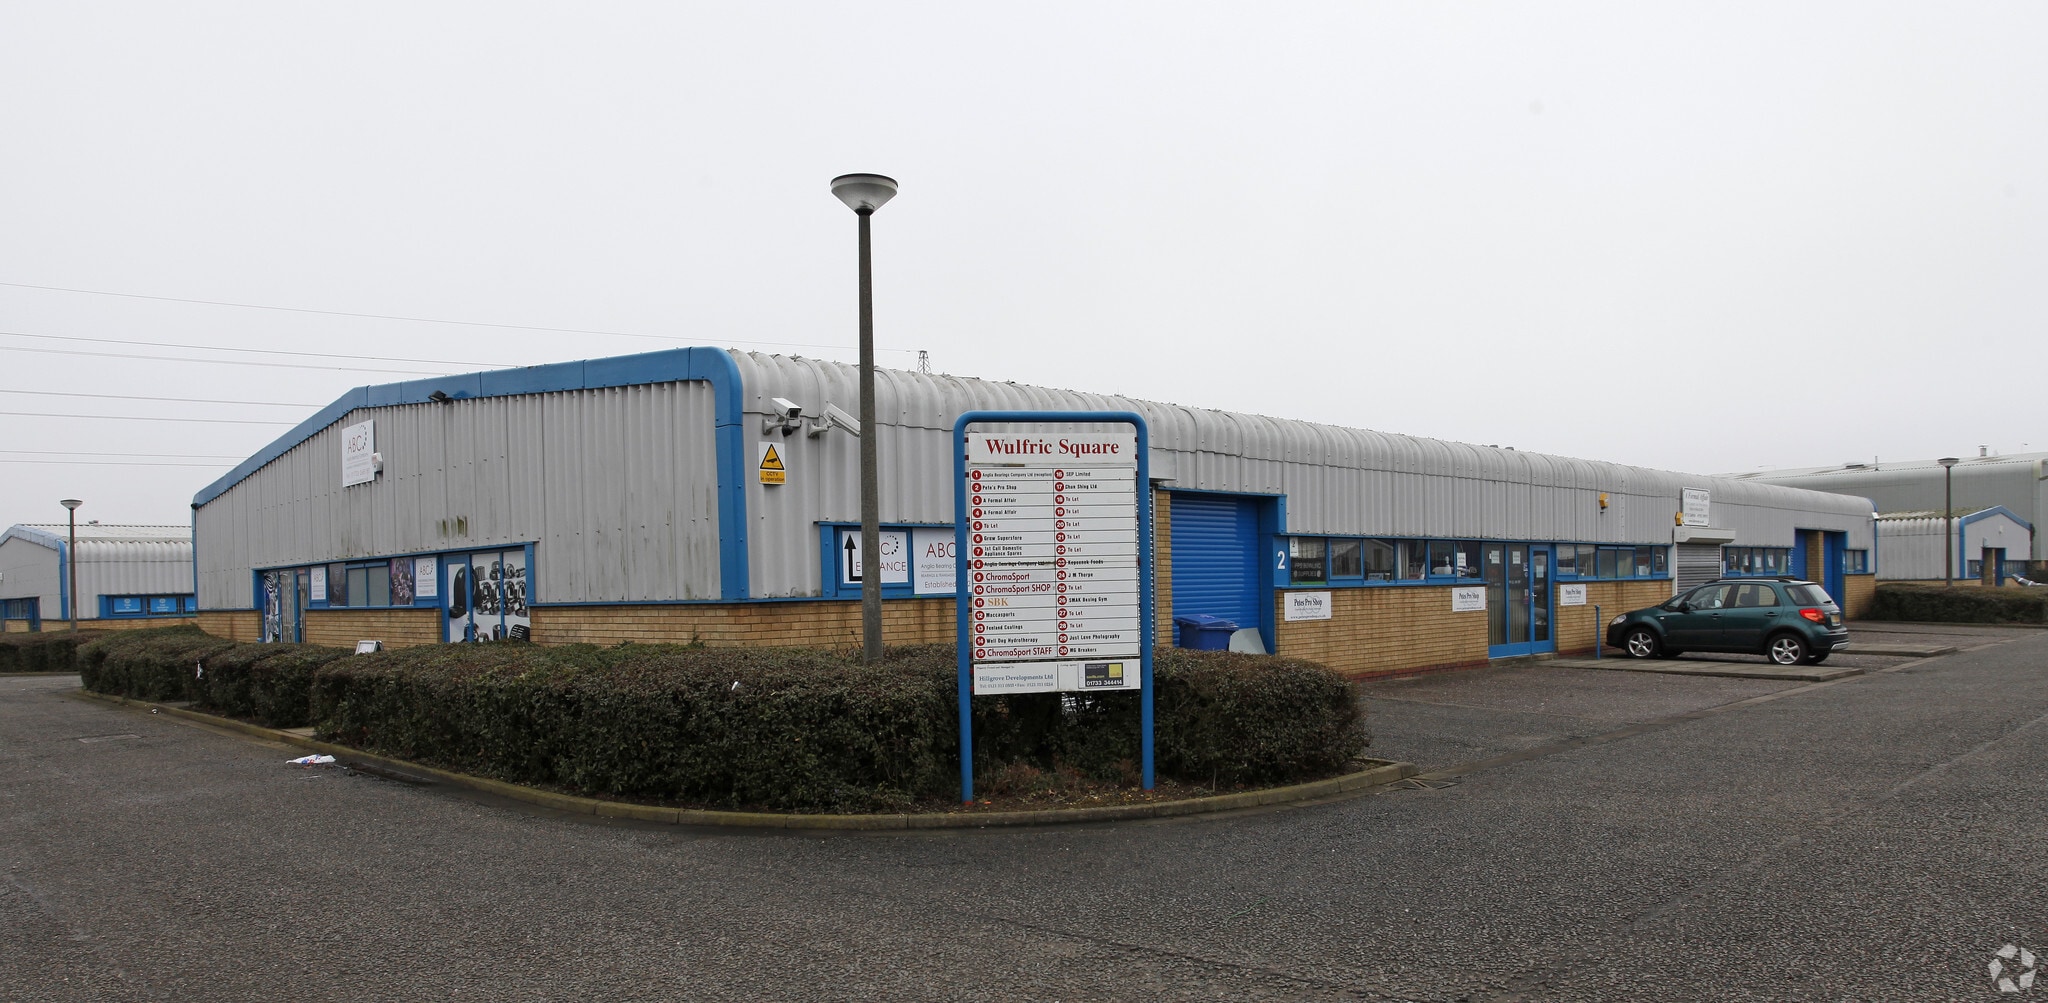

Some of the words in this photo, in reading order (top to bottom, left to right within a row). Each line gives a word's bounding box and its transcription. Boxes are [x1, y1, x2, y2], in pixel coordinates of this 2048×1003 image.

[348, 435, 361, 454] ABC
[986, 439, 1052, 454] Wulfric
[1059, 439, 1119, 458] Square
[926, 542, 956, 558] ABC
[1278, 550, 1286, 569] 2
[856, 561, 906, 571] EANCE
[986, 572, 1030, 582] ChromaSport
[986, 585, 1030, 594] ChromaSport
[1032, 584, 1051, 592] SHOP
[988, 598, 1008, 606] SBK
[1313, 598, 1322, 607] Shop
[987, 648, 1031, 658] ChromaSport
[1033, 647, 1052, 655] STAFF
